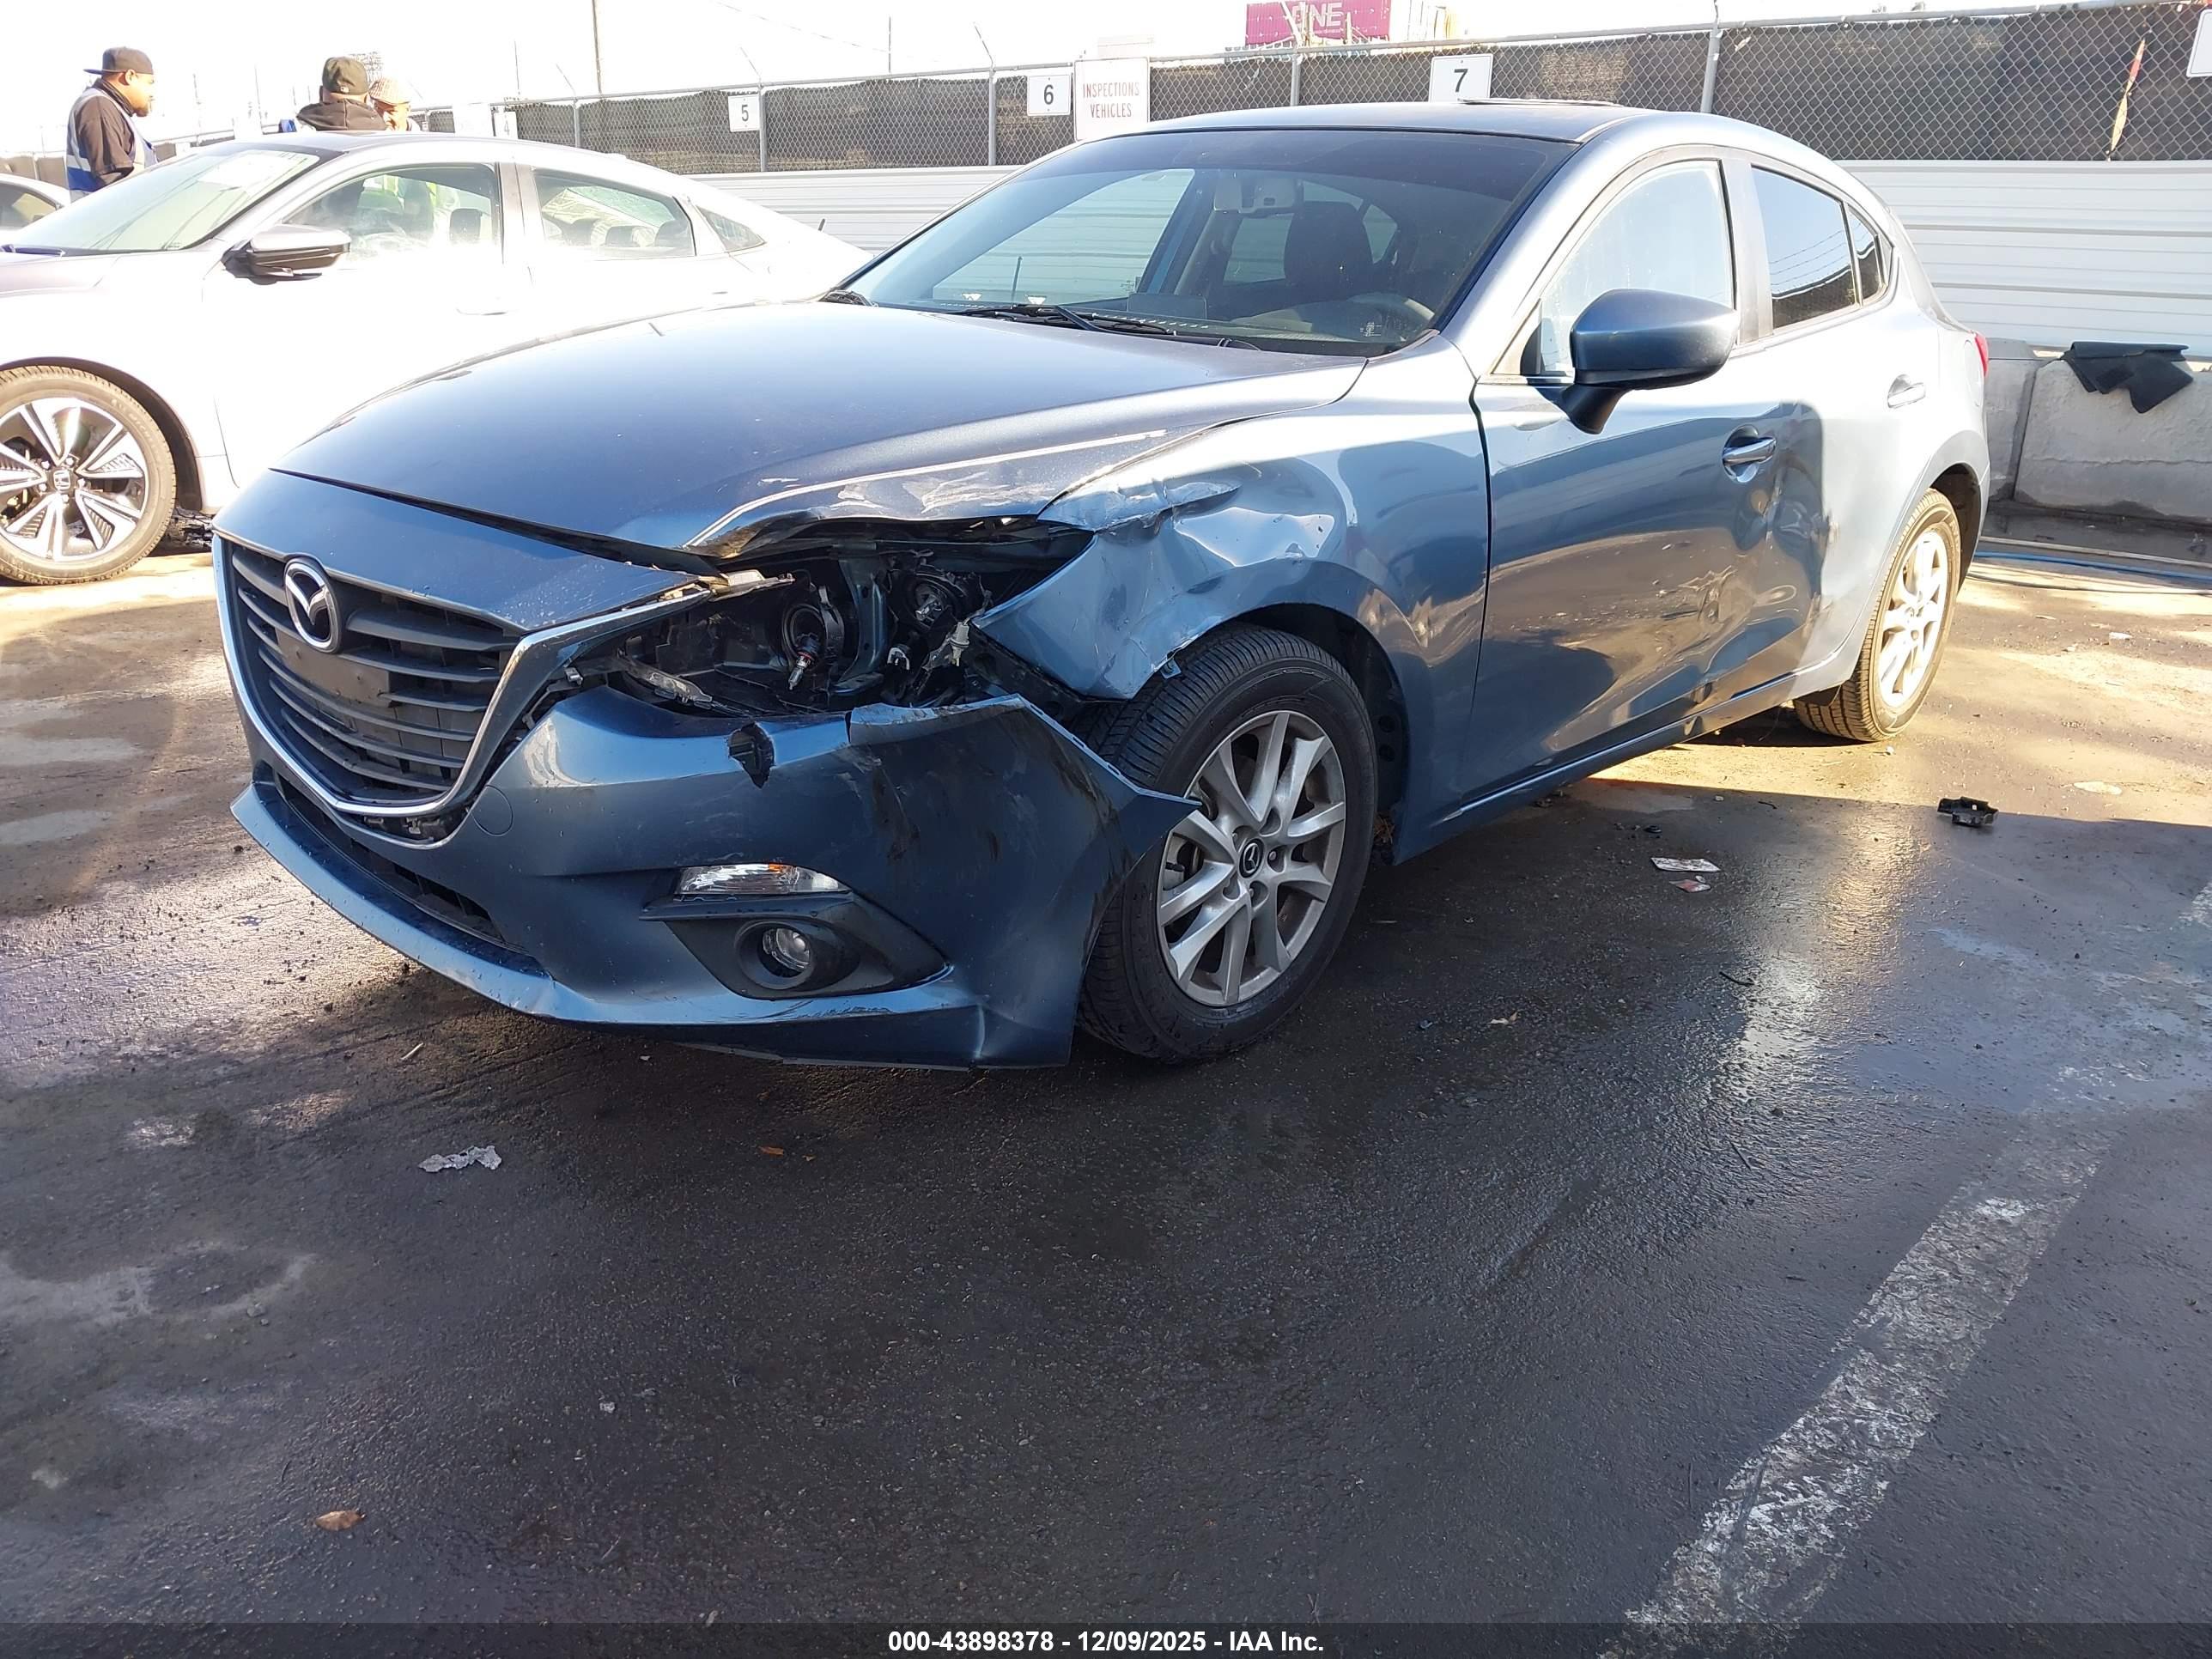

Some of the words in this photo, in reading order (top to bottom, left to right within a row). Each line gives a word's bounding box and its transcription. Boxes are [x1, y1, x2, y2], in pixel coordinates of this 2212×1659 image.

[1453, 68, 1468, 93] 7
[1043, 83, 1054, 105] 6
[1082, 82, 1139, 98] INSPECTIONS
[741, 104, 749, 122] 5
[1090, 102, 1132, 118] VEHICLES
[503, 120, 510, 136] 4
